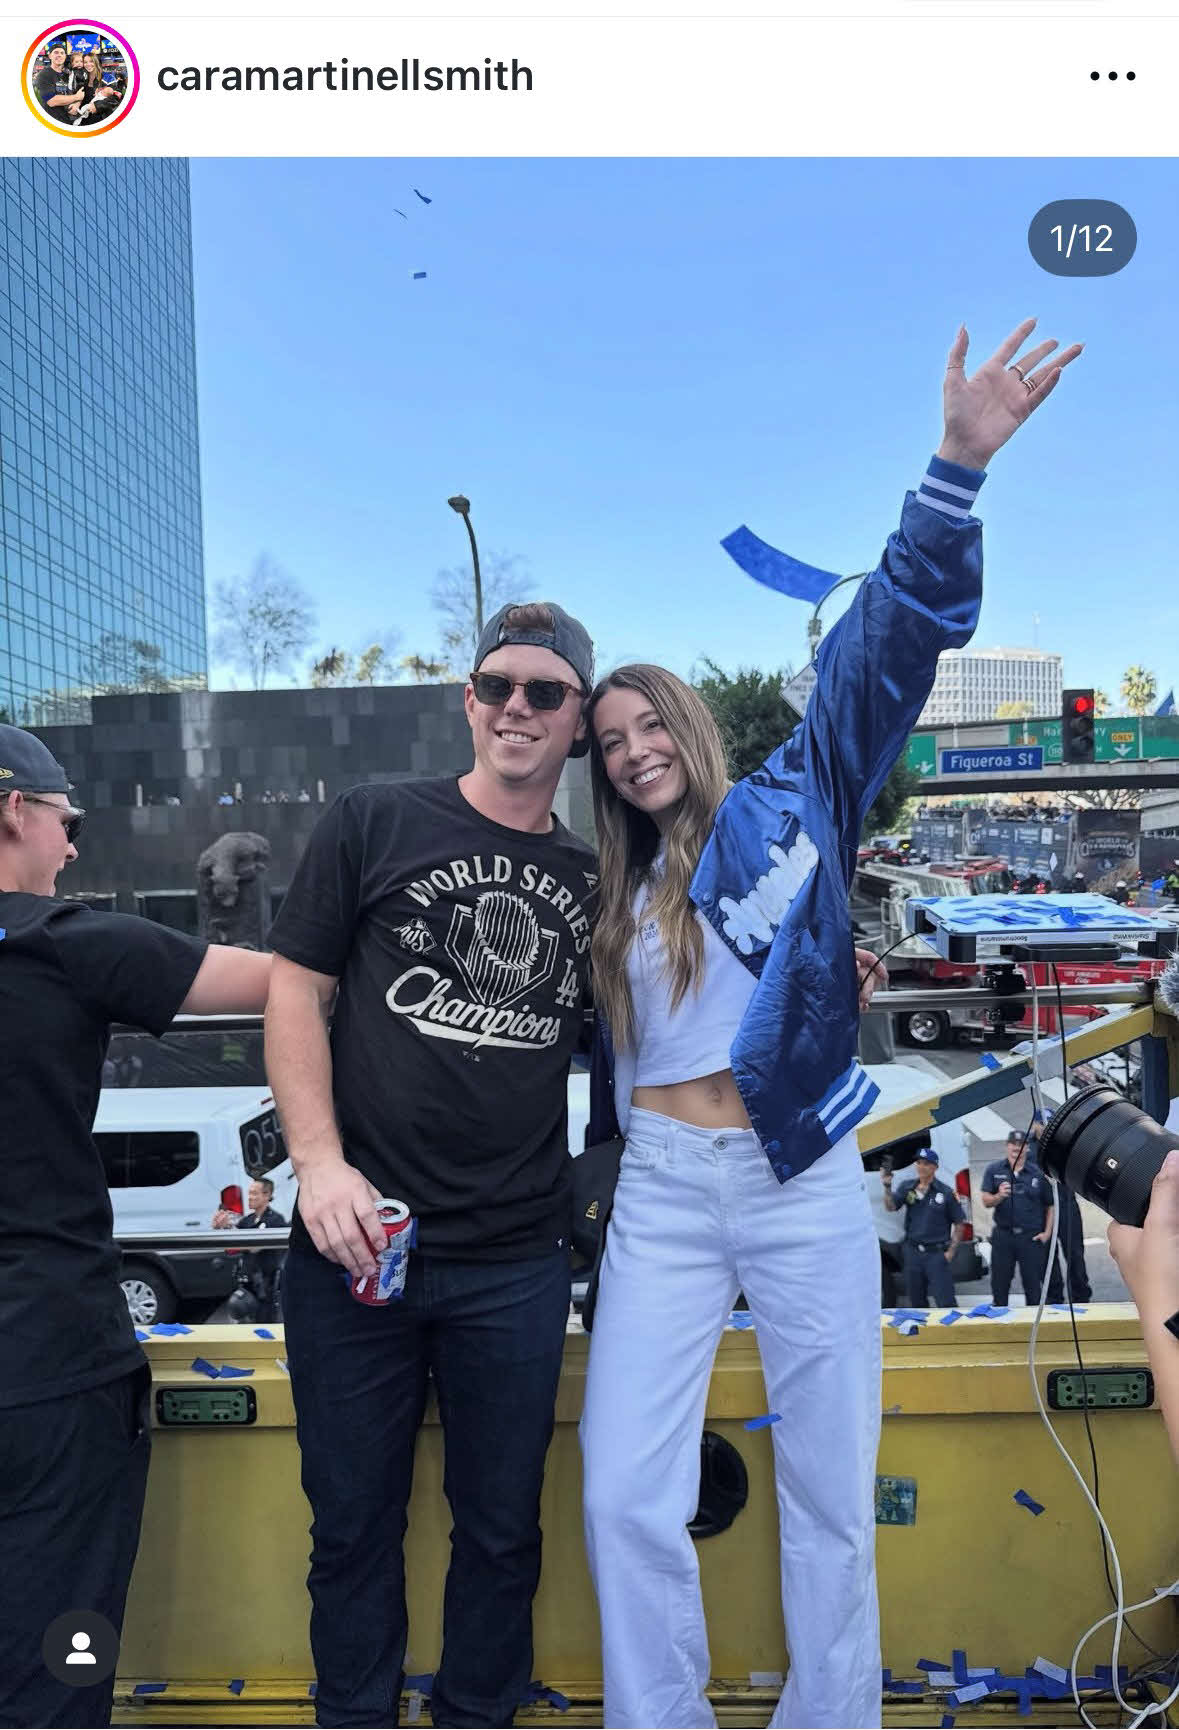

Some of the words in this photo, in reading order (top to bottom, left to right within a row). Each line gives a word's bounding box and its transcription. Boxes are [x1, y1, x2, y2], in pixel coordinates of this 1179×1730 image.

[950, 753, 1012, 772] Figueroa
[1018, 751, 1034, 767] St
[404, 854, 513, 908] WORLD
[519, 863, 592, 954] SERIES
[385, 965, 561, 1047] Champions
[554, 957, 580, 1009] LA
